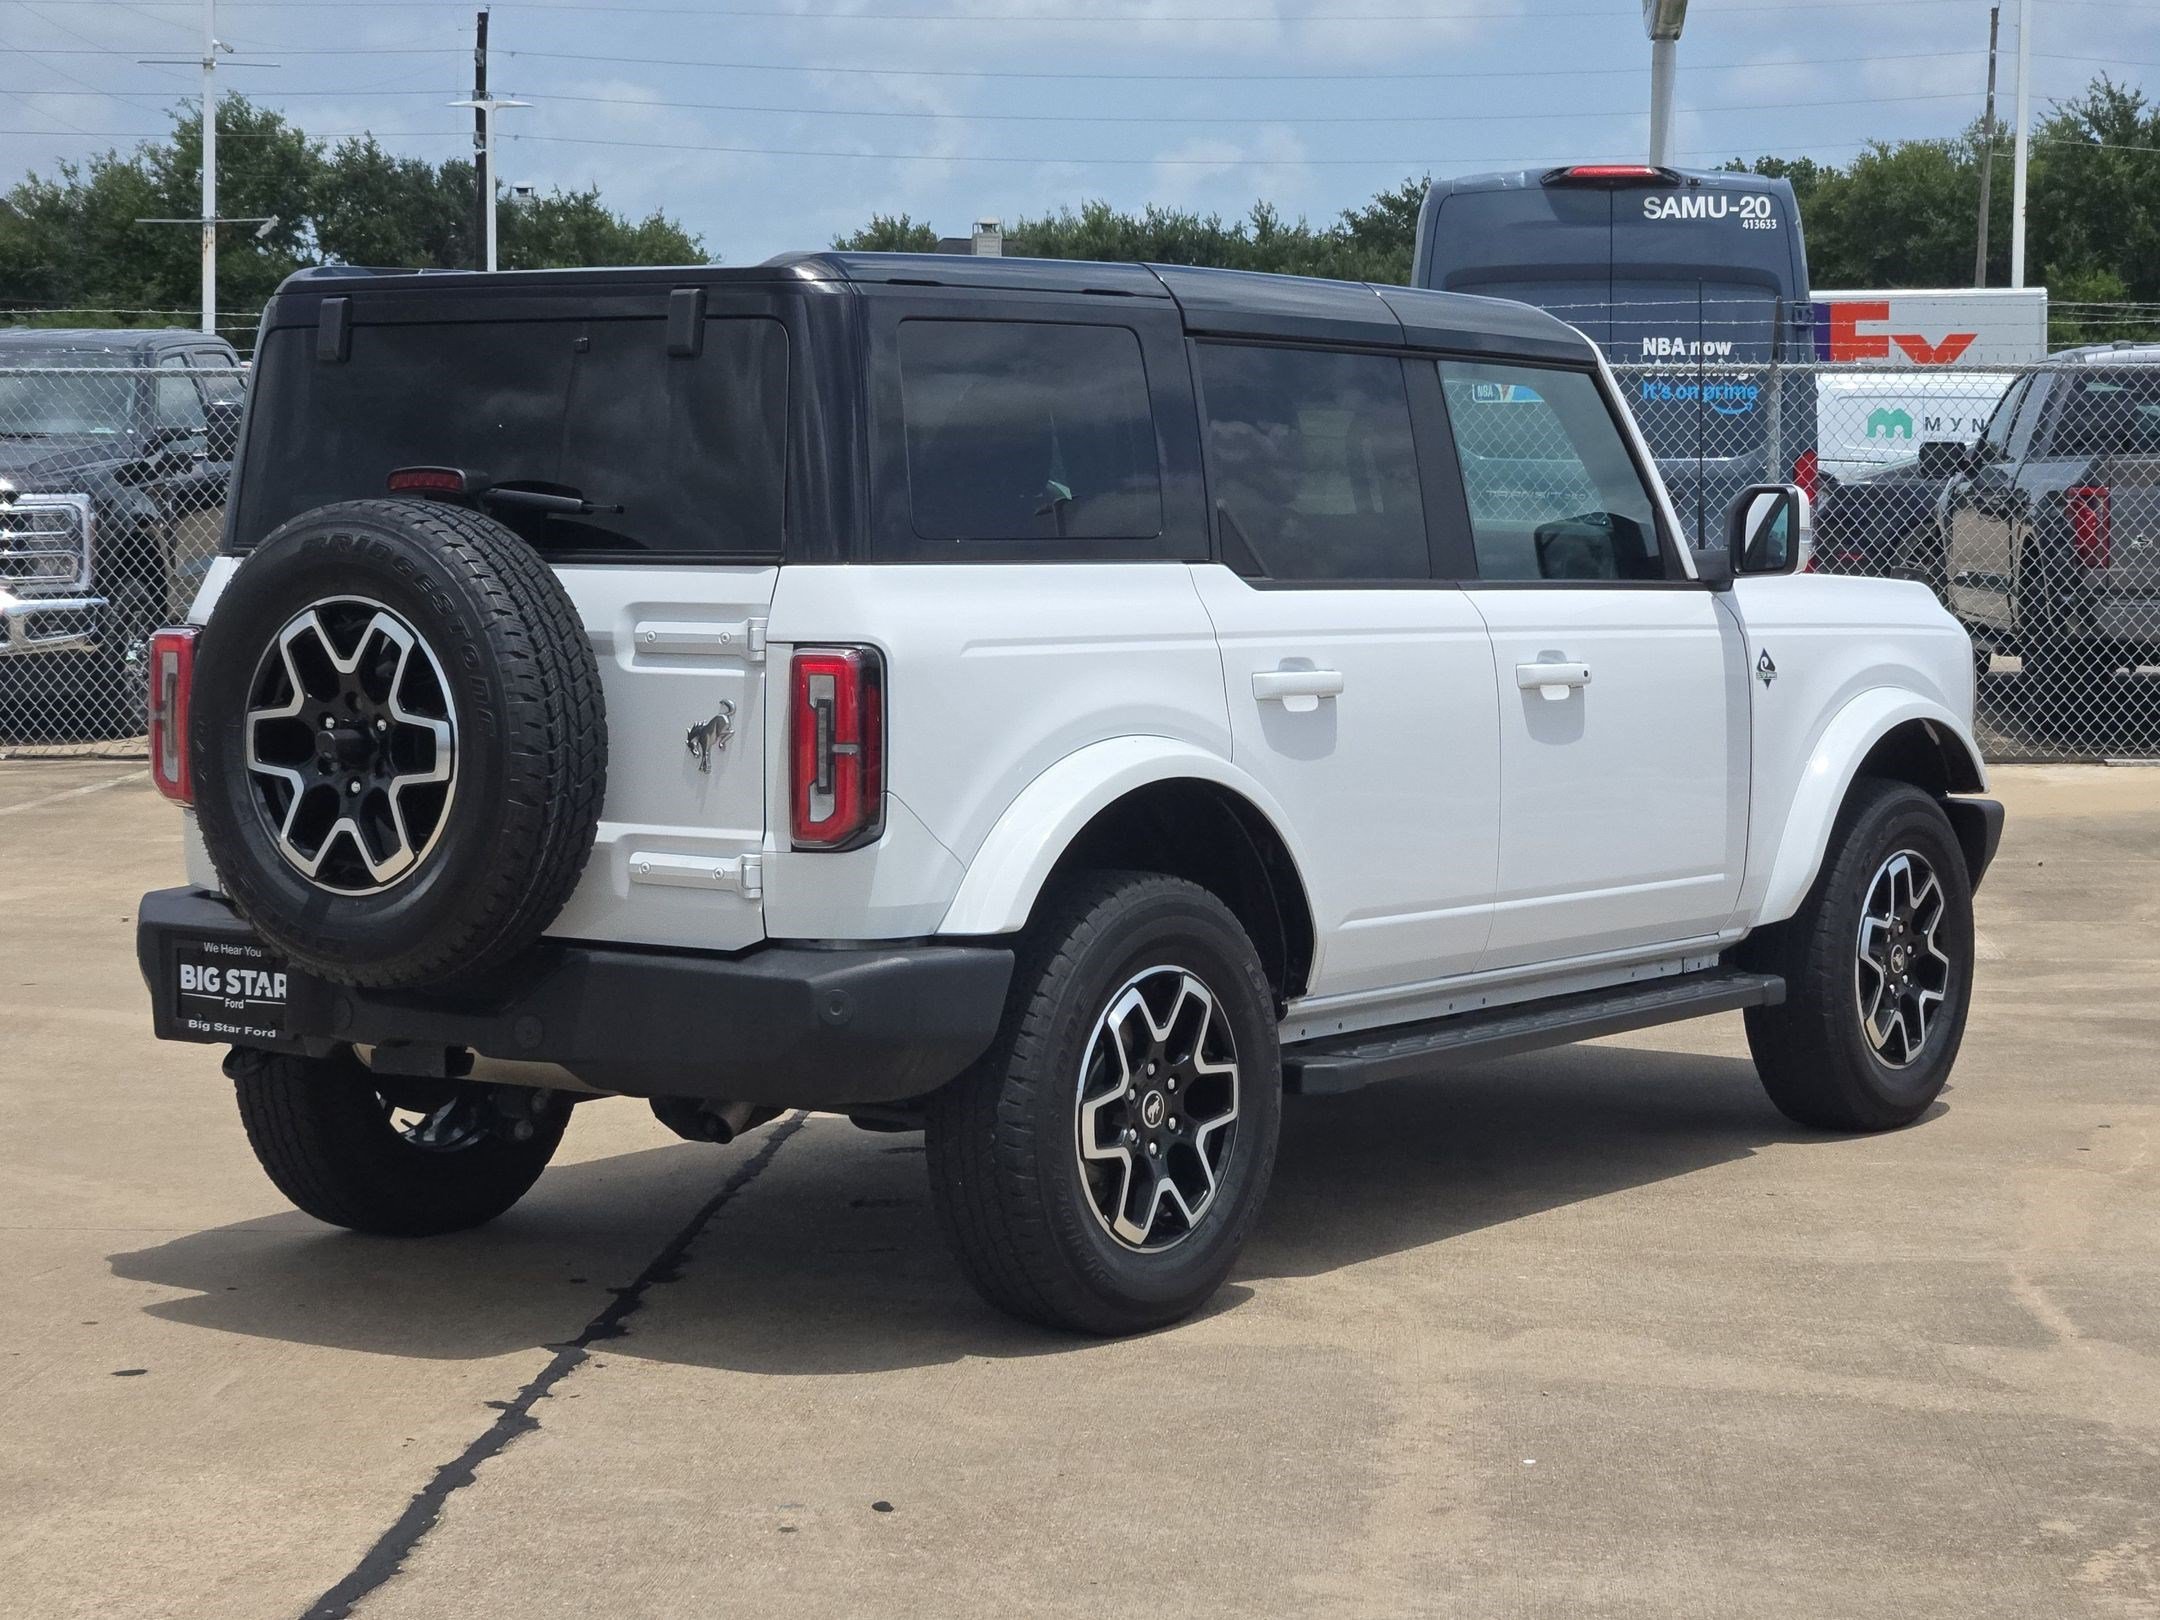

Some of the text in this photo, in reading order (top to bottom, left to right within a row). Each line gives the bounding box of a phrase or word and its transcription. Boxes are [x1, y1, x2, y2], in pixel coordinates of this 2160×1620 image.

[1643, 195, 1771, 219] SAMU-20
[1742, 219, 1777, 229] 413633
[1643, 337, 1732, 355] NBA now
[1477, 386, 1493, 397] NBA
[1643, 383, 1758, 402] It's on prime
[204, 942, 262, 957] We Hear You
[180, 964, 287, 999] BIG STAR
[224, 998, 244, 1009] Ford
[188, 1019, 276, 1038] Big Star Ford
